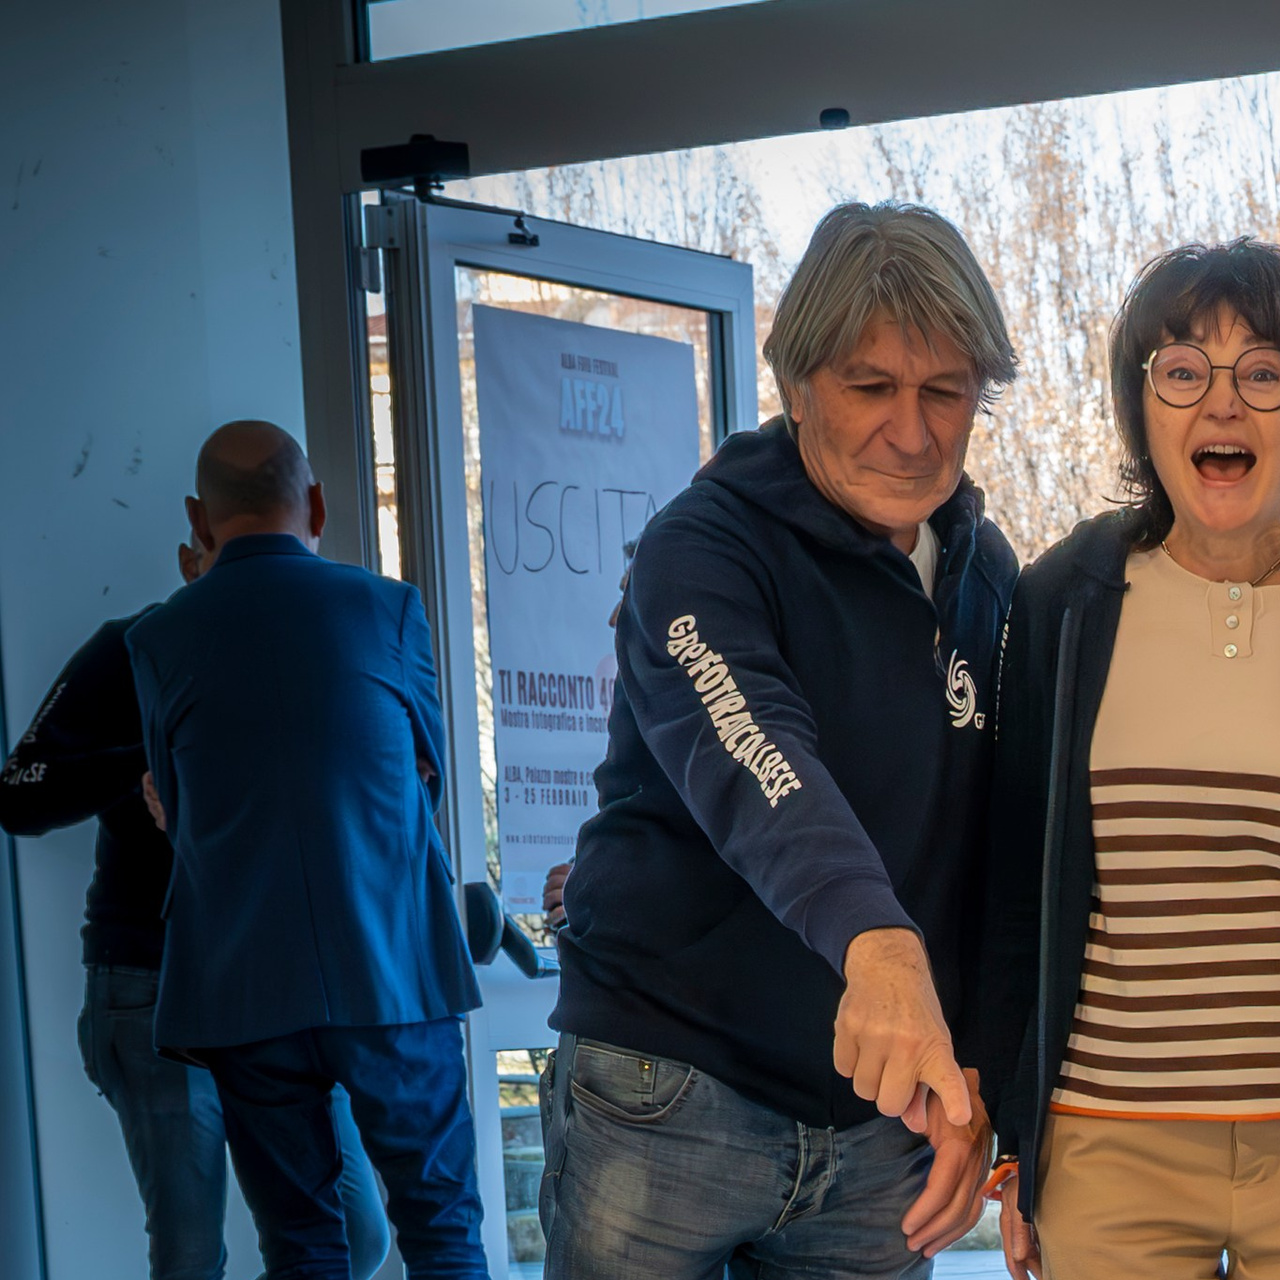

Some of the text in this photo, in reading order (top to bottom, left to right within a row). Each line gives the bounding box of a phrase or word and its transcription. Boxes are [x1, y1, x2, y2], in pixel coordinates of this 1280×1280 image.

[560, 377, 625, 439] AFF24
[498, 669, 513, 705] TI
[517, 670, 595, 711] RACCONTO
[500, 708, 529, 729] Mostra
[504, 786, 510, 804] 3
[524, 787, 536, 805] 25
[540, 788, 588, 807] FEBBRAIO
